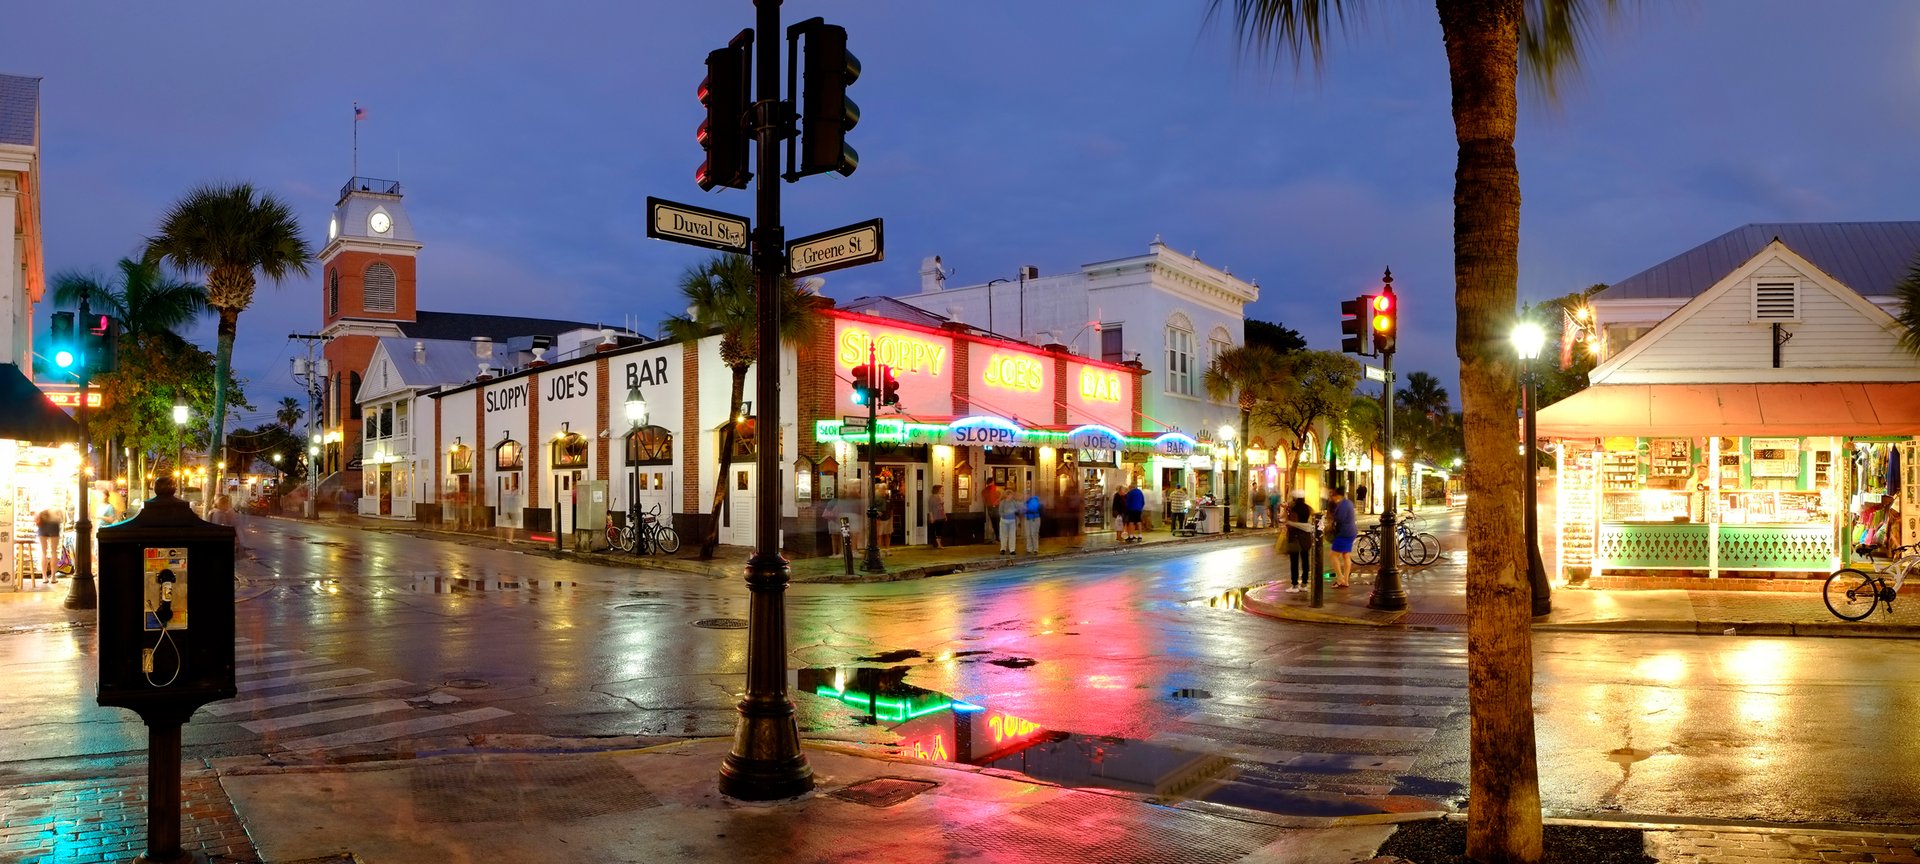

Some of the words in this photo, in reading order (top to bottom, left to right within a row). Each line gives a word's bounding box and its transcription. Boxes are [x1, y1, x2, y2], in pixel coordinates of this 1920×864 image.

[672, 213, 713, 238] Duval
[717, 224, 731, 240] St
[803, 243, 845, 264] Greene
[849, 235, 862, 253] St
[841, 331, 945, 375] SLOPPY
[984, 355, 1043, 391] JOE'S
[1081, 369, 1120, 401] BAR
[486, 382, 529, 413] SLOPPY
[547, 370, 588, 402] JOE'S
[626, 356, 668, 390] BAR
[956, 426, 1017, 442] SLOPPY
[1083, 435, 1117, 449] JOE'S
[1166, 441, 1185, 453] BAR
